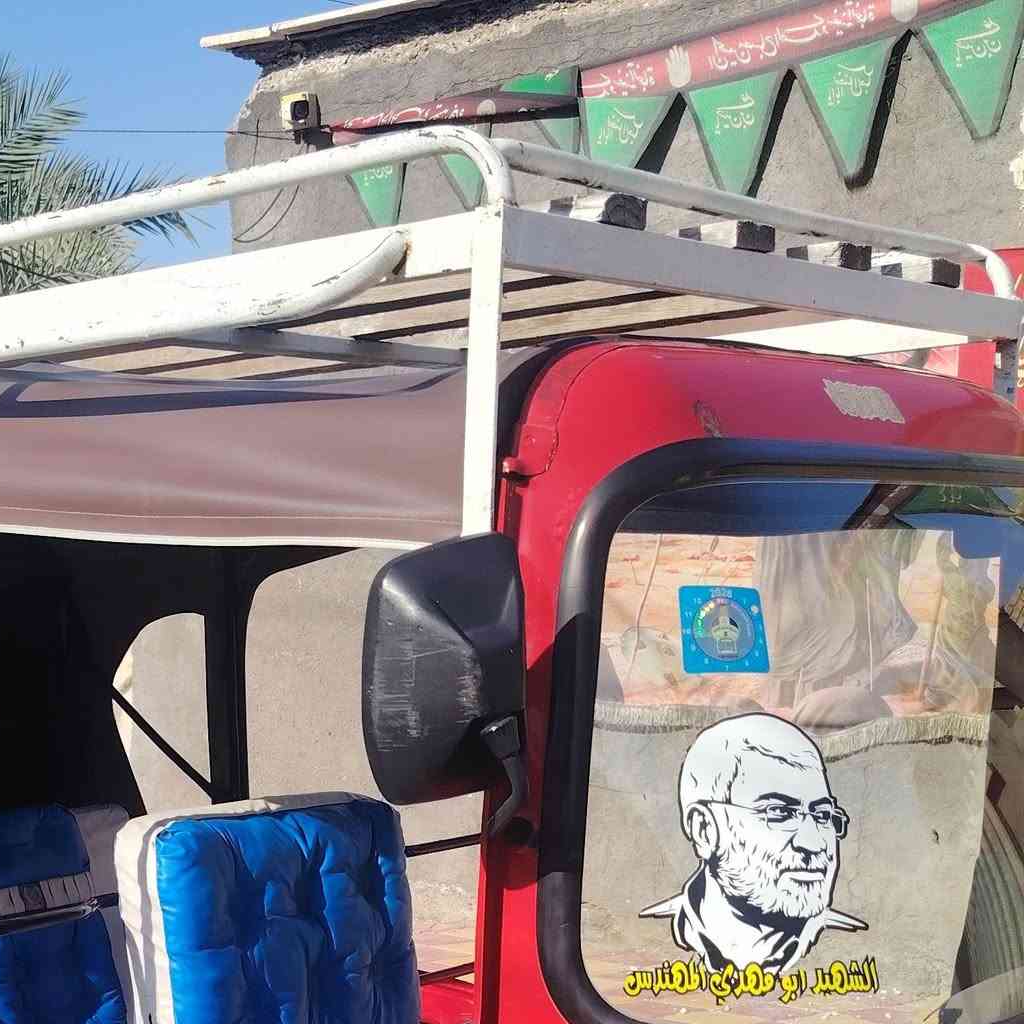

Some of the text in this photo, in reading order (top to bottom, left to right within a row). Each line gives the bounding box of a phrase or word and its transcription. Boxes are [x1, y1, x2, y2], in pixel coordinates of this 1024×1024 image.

[623, 956, 879, 1005] الشهيد ابو مهدي المهندس
